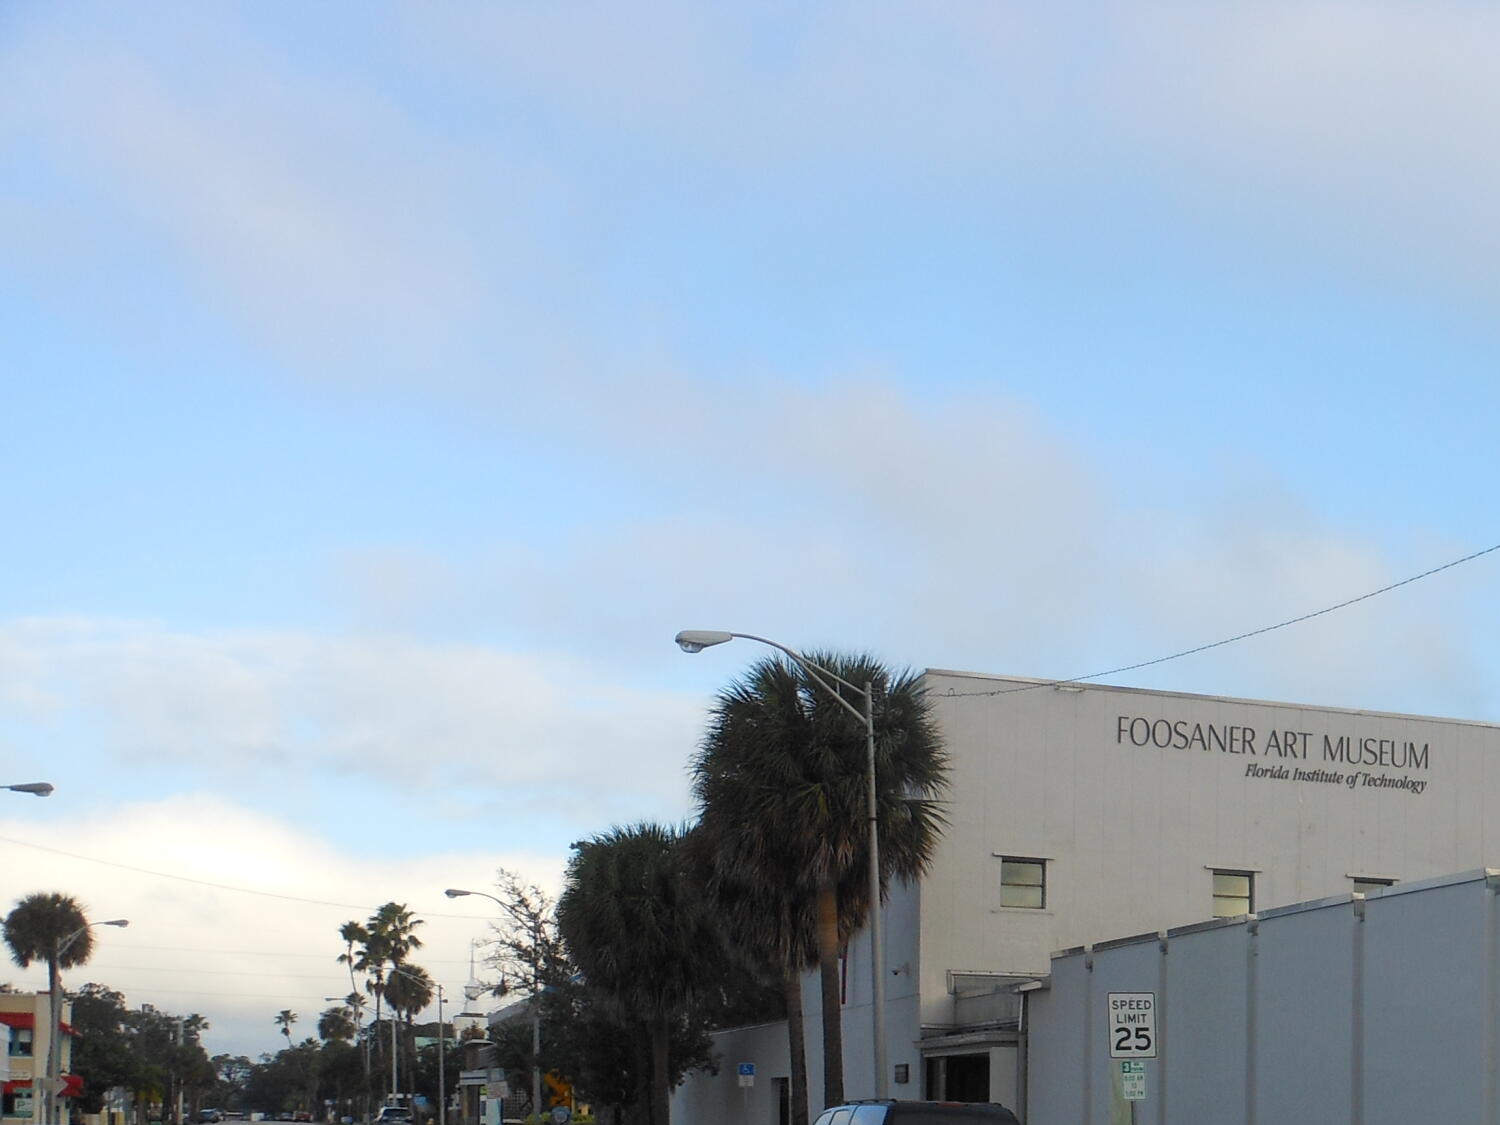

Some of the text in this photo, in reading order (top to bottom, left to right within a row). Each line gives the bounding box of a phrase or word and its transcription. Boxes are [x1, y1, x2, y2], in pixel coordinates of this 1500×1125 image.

[1117, 716, 1429, 769] FOOSANER ART MUSEUM
[1245, 763, 1427, 794] Florida Institute of Technology
[1112, 1000, 1152, 1010] SPEED
[1116, 1014, 1147, 1024] LIMIT
[1115, 1027, 1152, 1051] 25
[1124, 1062, 1130, 1071] 3
